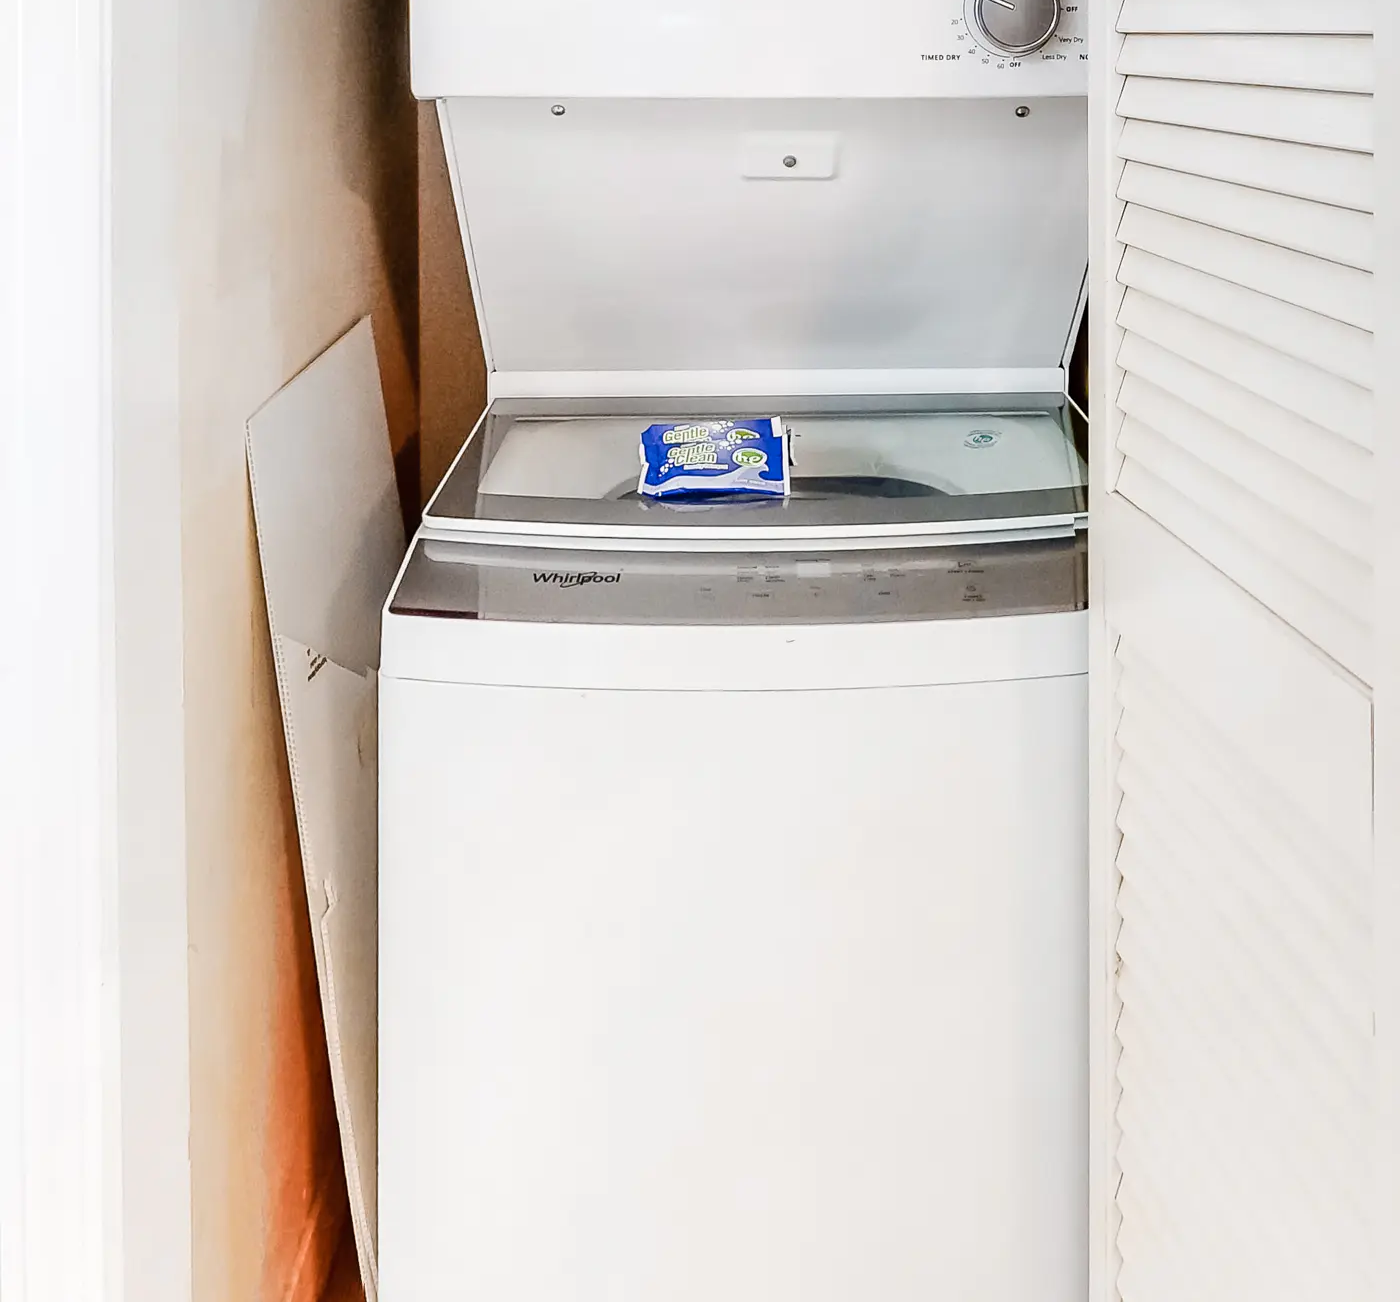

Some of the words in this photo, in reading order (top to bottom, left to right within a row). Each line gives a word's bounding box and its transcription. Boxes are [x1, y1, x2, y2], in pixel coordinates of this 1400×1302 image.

[996, 62, 1005, 70] 60
[664, 427, 707, 442] Gentle
[669, 444, 714, 457] Gentle
[675, 451, 715, 465] Clean
[532, 572, 621, 587] Whirlpool
